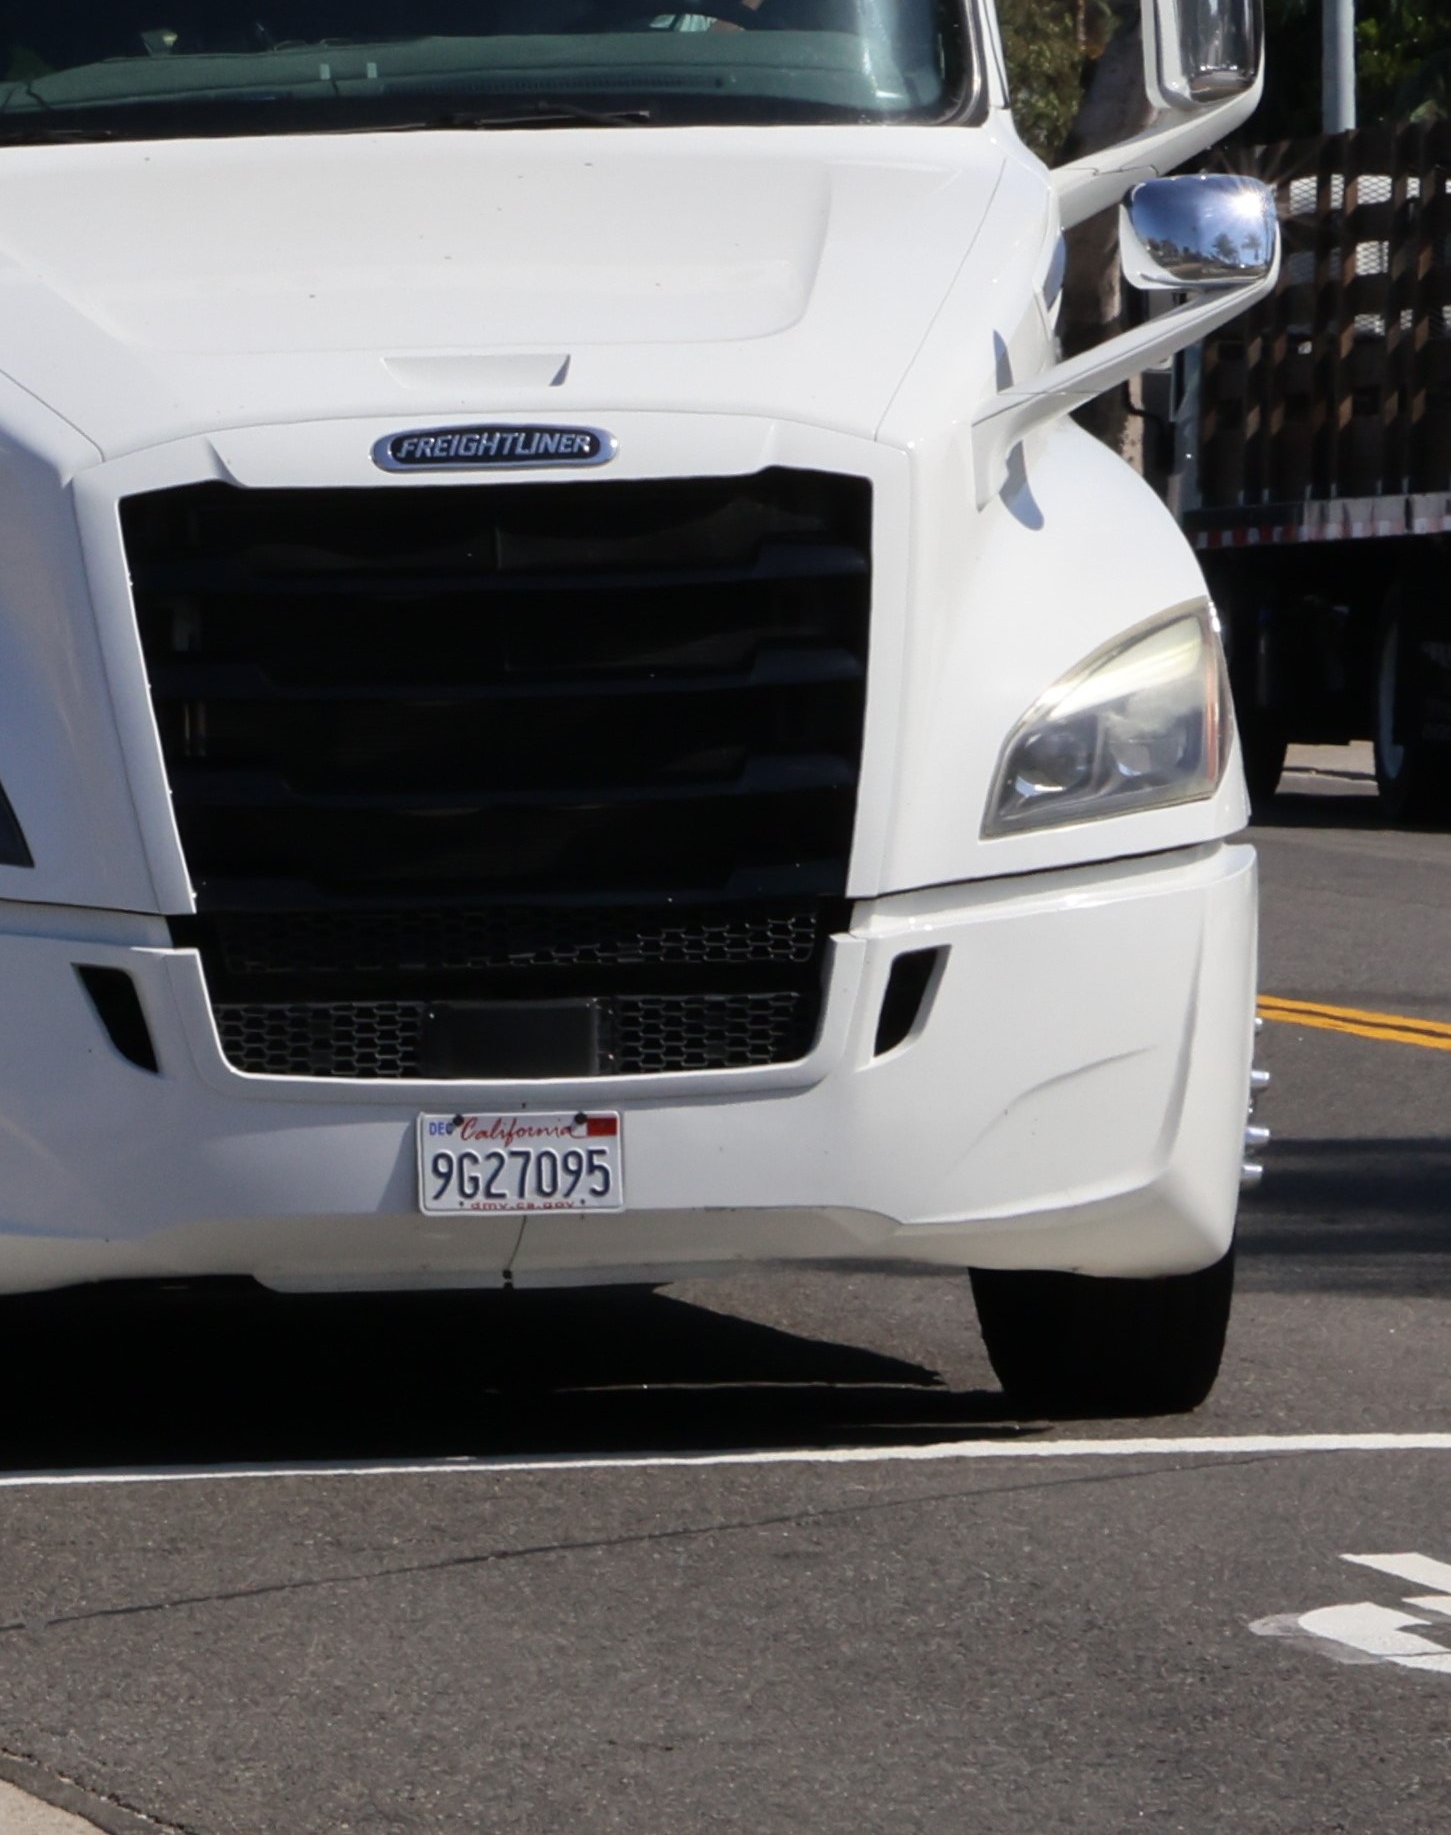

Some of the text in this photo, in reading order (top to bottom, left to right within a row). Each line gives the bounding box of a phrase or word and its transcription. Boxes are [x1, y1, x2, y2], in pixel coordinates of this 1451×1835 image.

[396, 431, 591, 459] FREIGHTLINER
[460, 1117, 584, 1148] California
[431, 1149, 612, 1201] 9G27095
[469, 1201, 576, 1211] dmv.ca.gov
